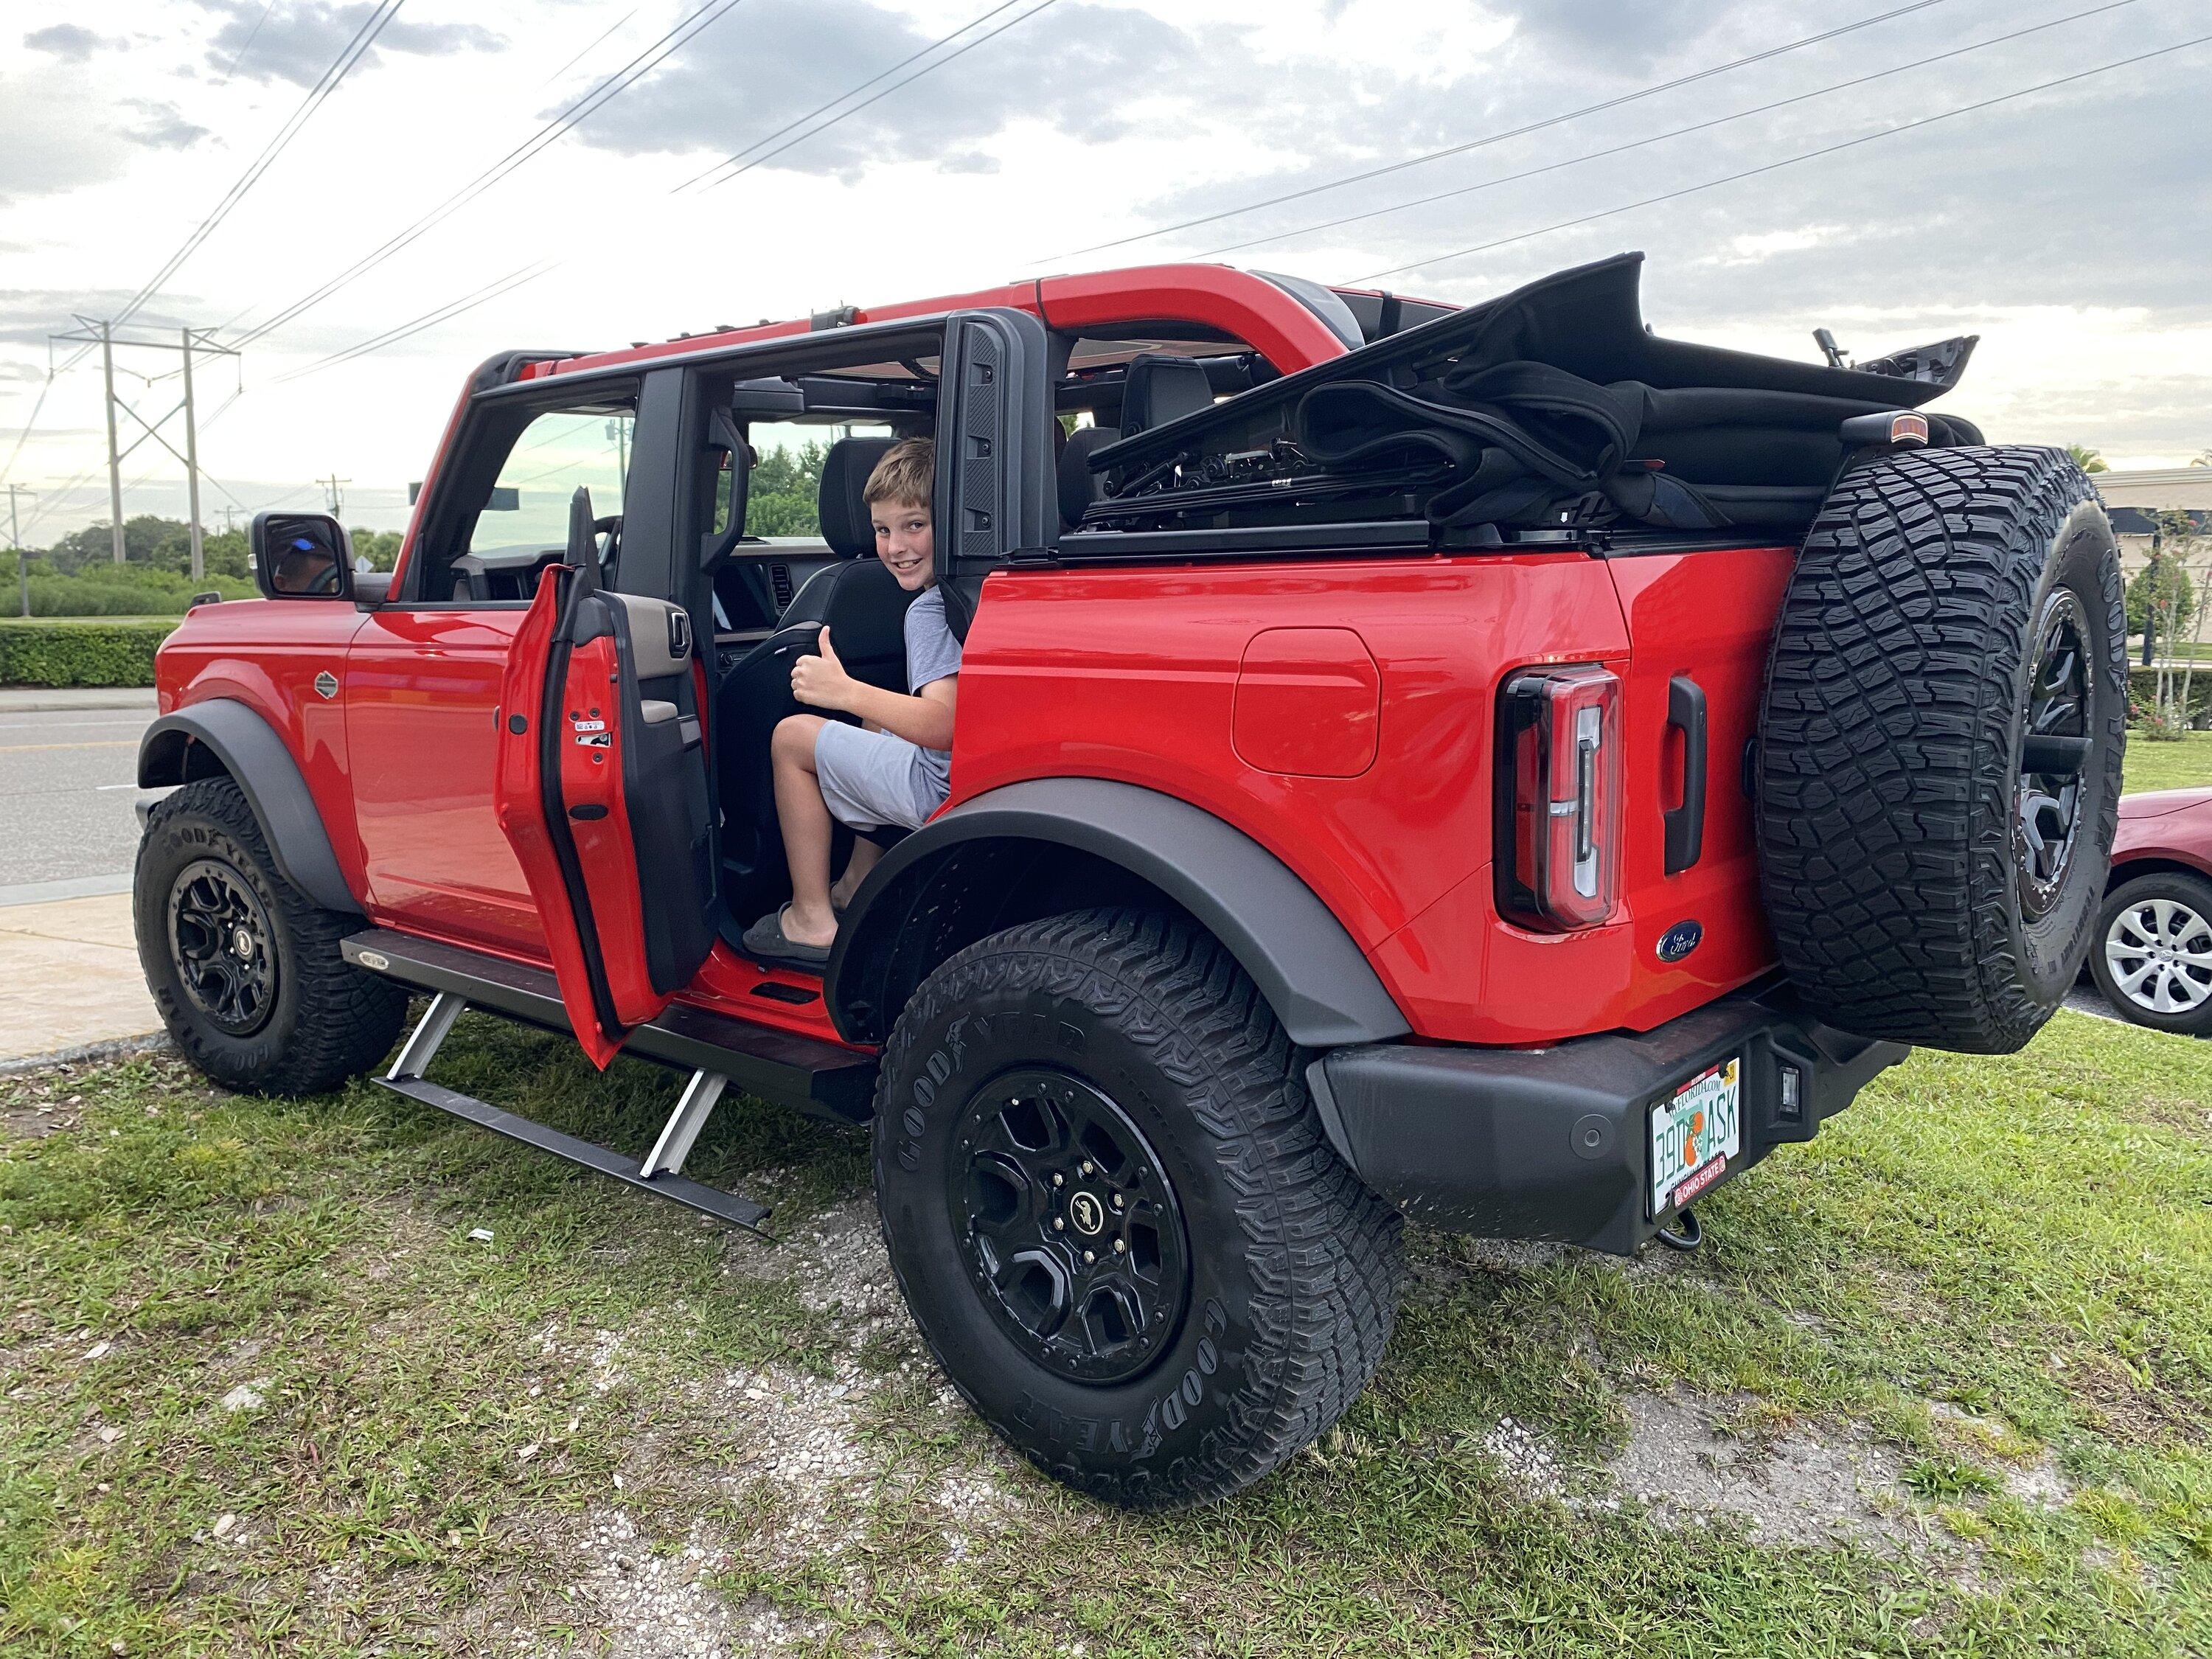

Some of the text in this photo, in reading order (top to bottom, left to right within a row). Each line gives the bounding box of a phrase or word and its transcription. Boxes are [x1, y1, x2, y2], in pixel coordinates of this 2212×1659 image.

[1671, 932, 1696, 956] Ford
[1683, 1161, 1719, 1199] OHIO STATE
